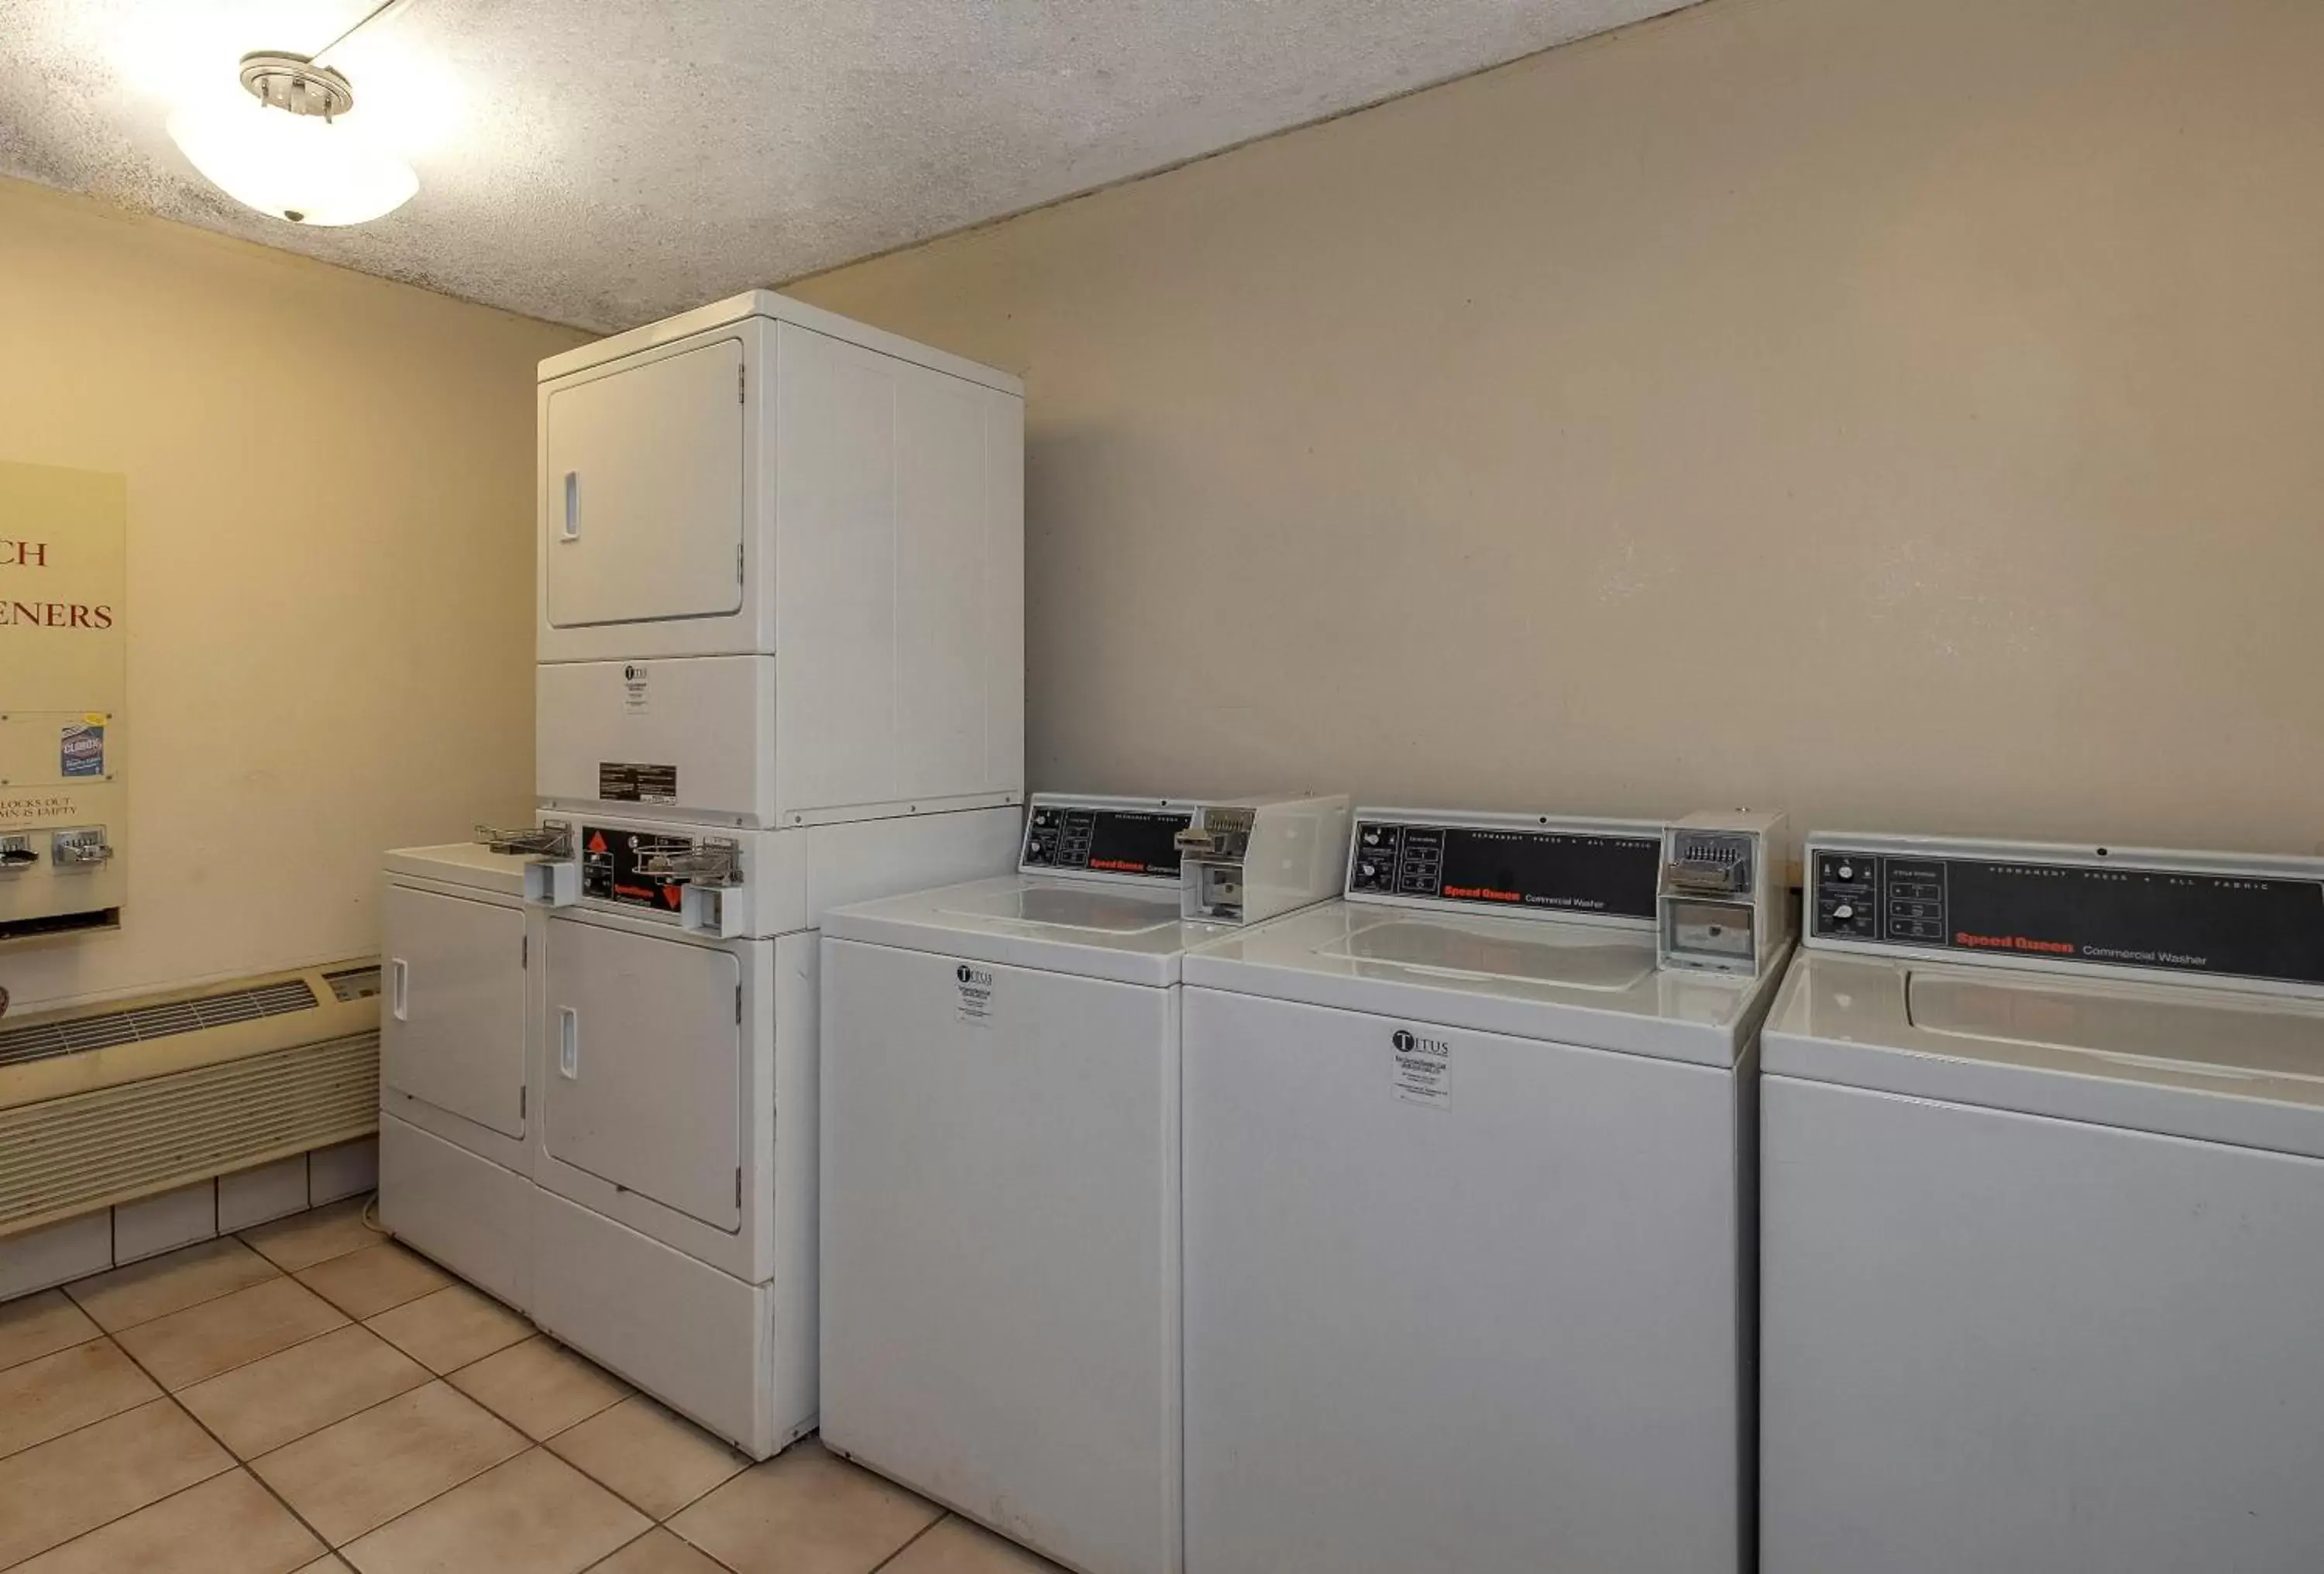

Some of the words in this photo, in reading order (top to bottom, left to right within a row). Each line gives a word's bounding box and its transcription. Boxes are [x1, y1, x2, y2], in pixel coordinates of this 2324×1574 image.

[1444, 885, 1480, 897] Speed
[1482, 888, 1521, 902] Queen
[1525, 894, 1571, 906] Commercial
[1956, 932, 2013, 947] Speed
[2014, 936, 2075, 953] Queen
[2082, 944, 2157, 961] Commercial
[2159, 952, 2207, 965] Washer
[1392, 1030, 1448, 1053] TITUS
